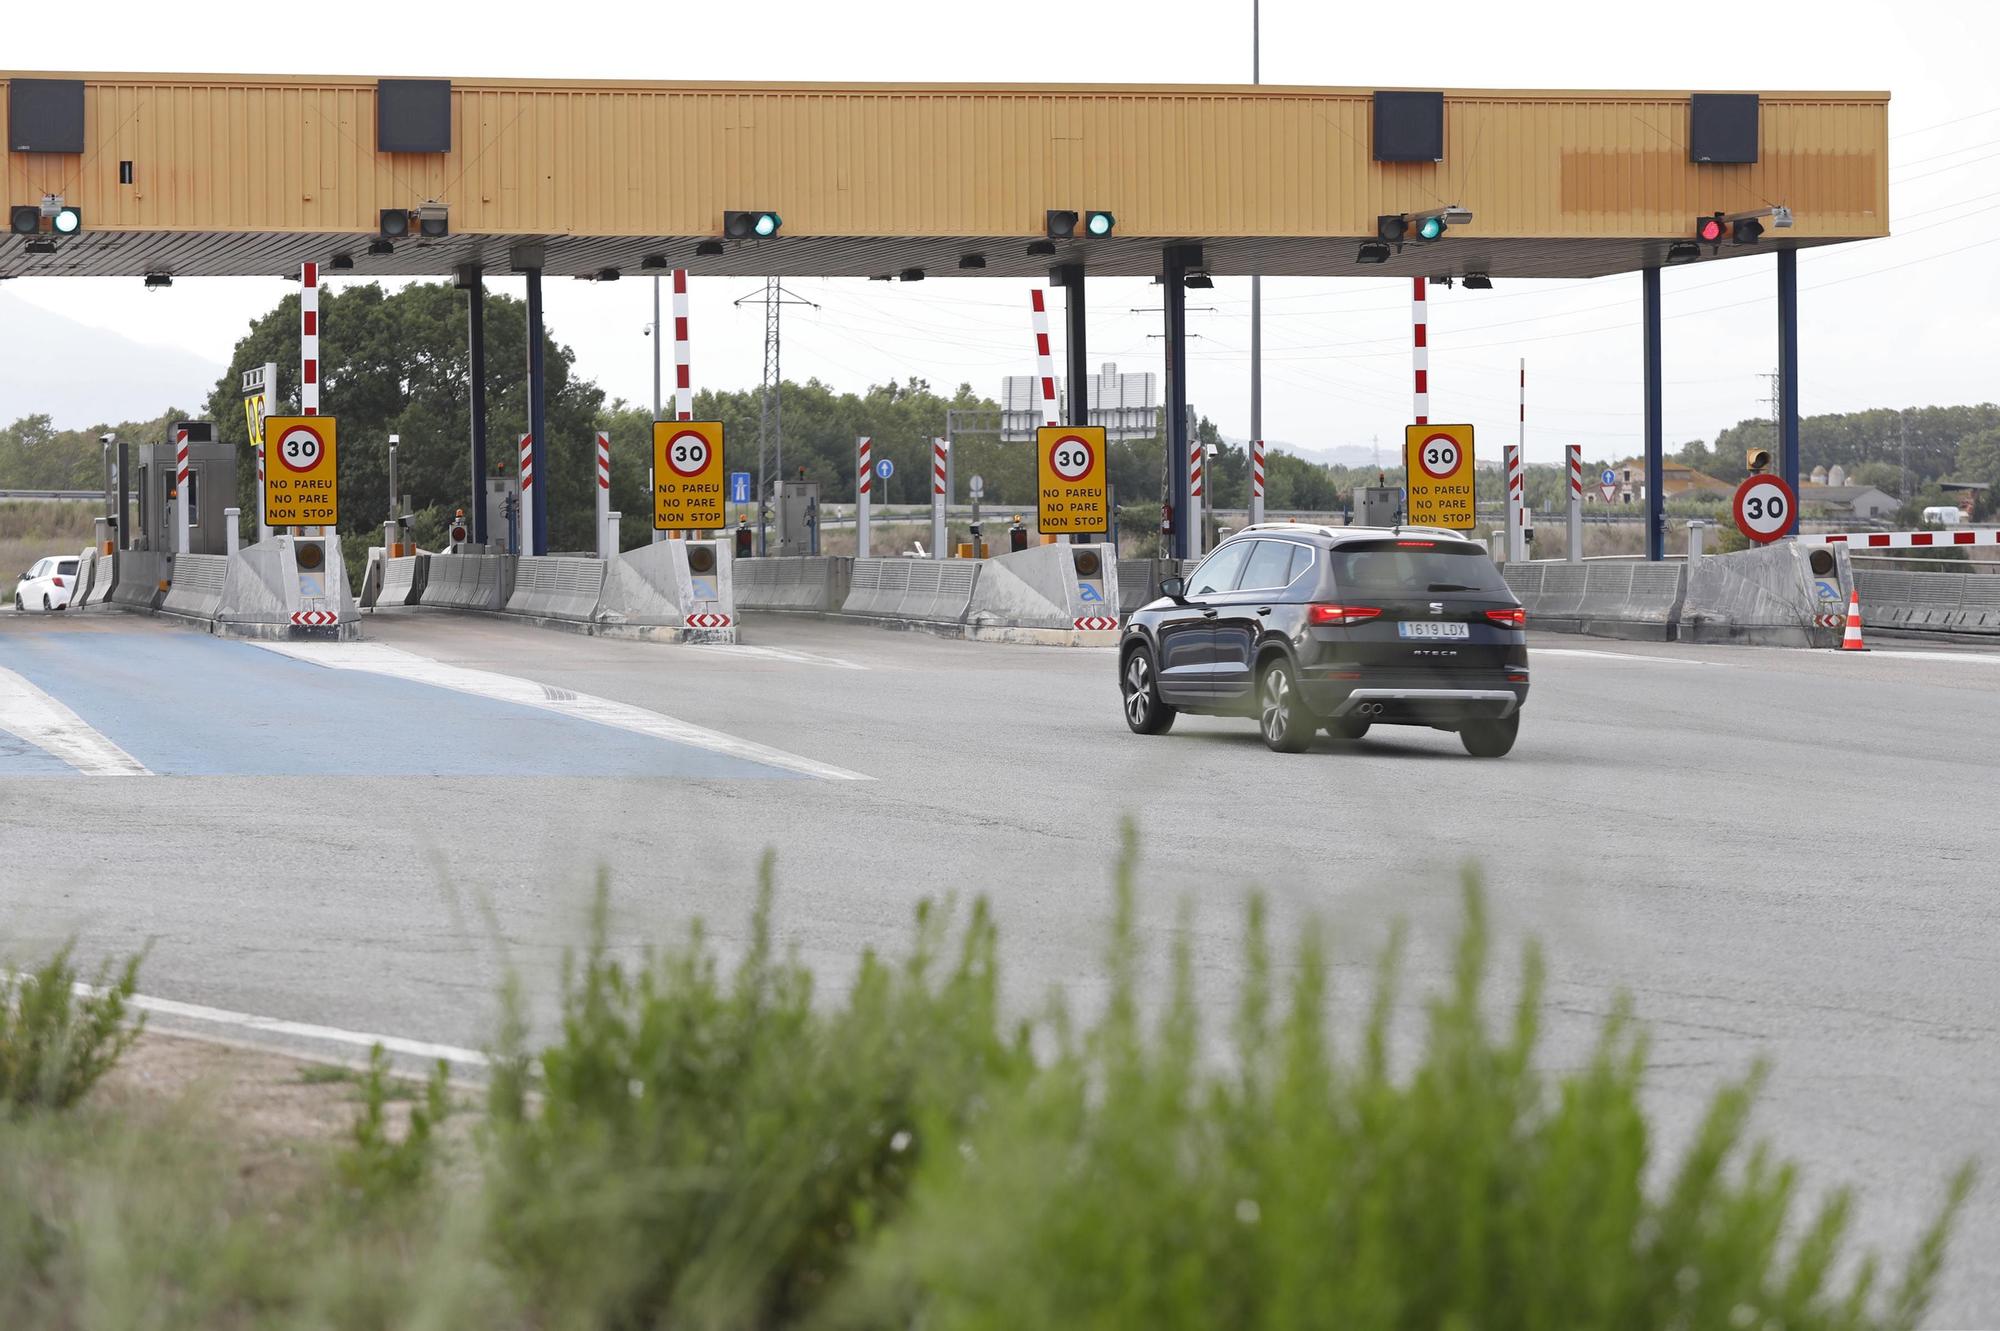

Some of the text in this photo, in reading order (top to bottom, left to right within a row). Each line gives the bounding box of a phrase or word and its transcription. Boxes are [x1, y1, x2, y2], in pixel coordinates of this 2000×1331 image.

[288, 441, 315, 458] 30
[676, 446, 702, 462] 30
[1059, 451, 1085, 467] 30
[1428, 449, 1453, 465] 30
[271, 480, 333, 489] NO PAREU
[659, 484, 720, 493] NO PAREU
[1044, 489, 1102, 497] NO PAREU
[1413, 486, 1470, 495] NO PAREU
[275, 495, 329, 504] NO PARE
[664, 499, 716, 507] NO PARE
[1048, 503, 1099, 512] NO PARE
[1417, 500, 1467, 509] NO PARE
[1747, 496, 1783, 519] 30
[270, 509, 334, 518] NON STOP
[659, 513, 721, 522] NON STOP
[1043, 517, 1104, 526] NON STOP
[1412, 514, 1471, 523] NON STOP
[1409, 623, 1466, 637] 1619 LDX
